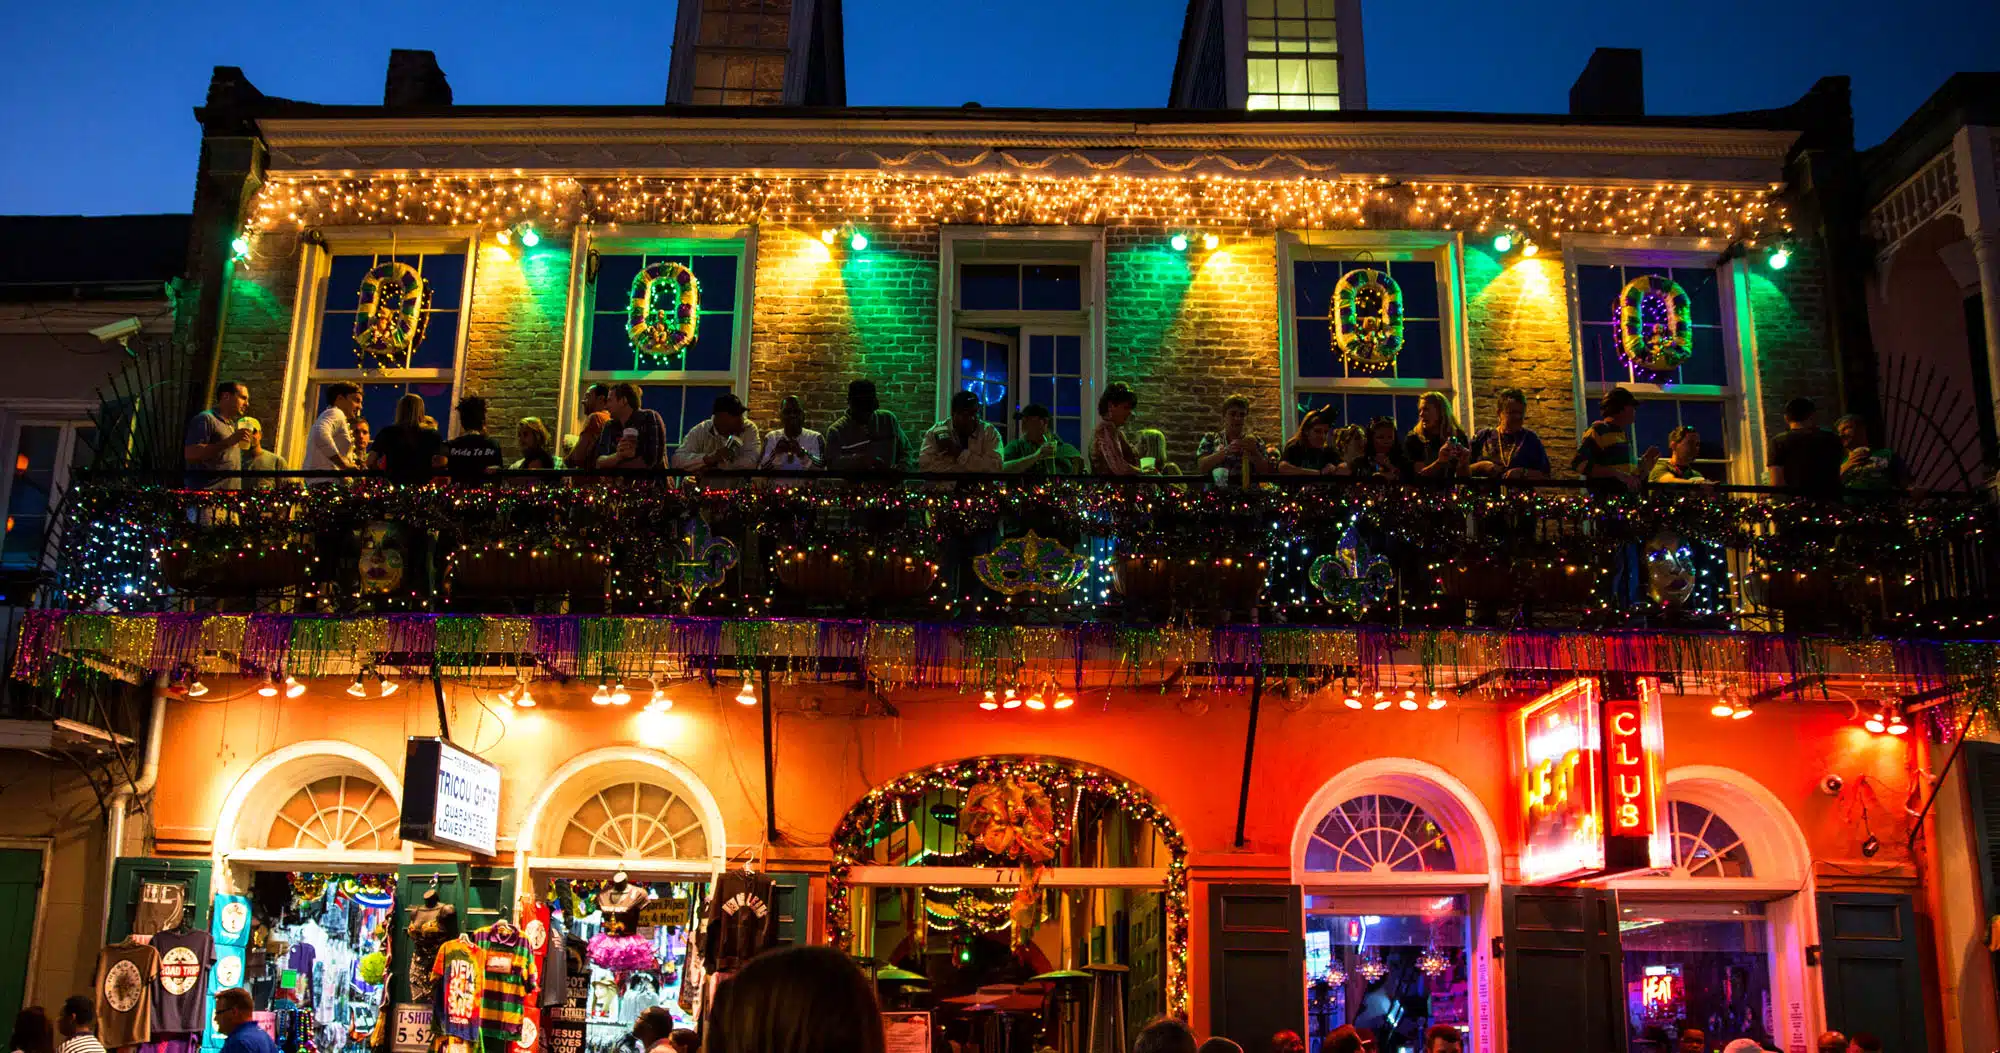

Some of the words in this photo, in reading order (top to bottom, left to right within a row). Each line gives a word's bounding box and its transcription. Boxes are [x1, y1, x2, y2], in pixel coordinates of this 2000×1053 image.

[450, 447, 471, 456] Bride
[473, 447, 483, 456] To
[439, 769, 472, 803] TRICOU
[474, 783, 497, 813] GIFTS
[438, 817, 467, 837] LOWEST
[450, 960, 474, 982] NEW
[1642, 976, 1673, 1006] HEAT
[399, 1011, 432, 1024] T-SHIR
